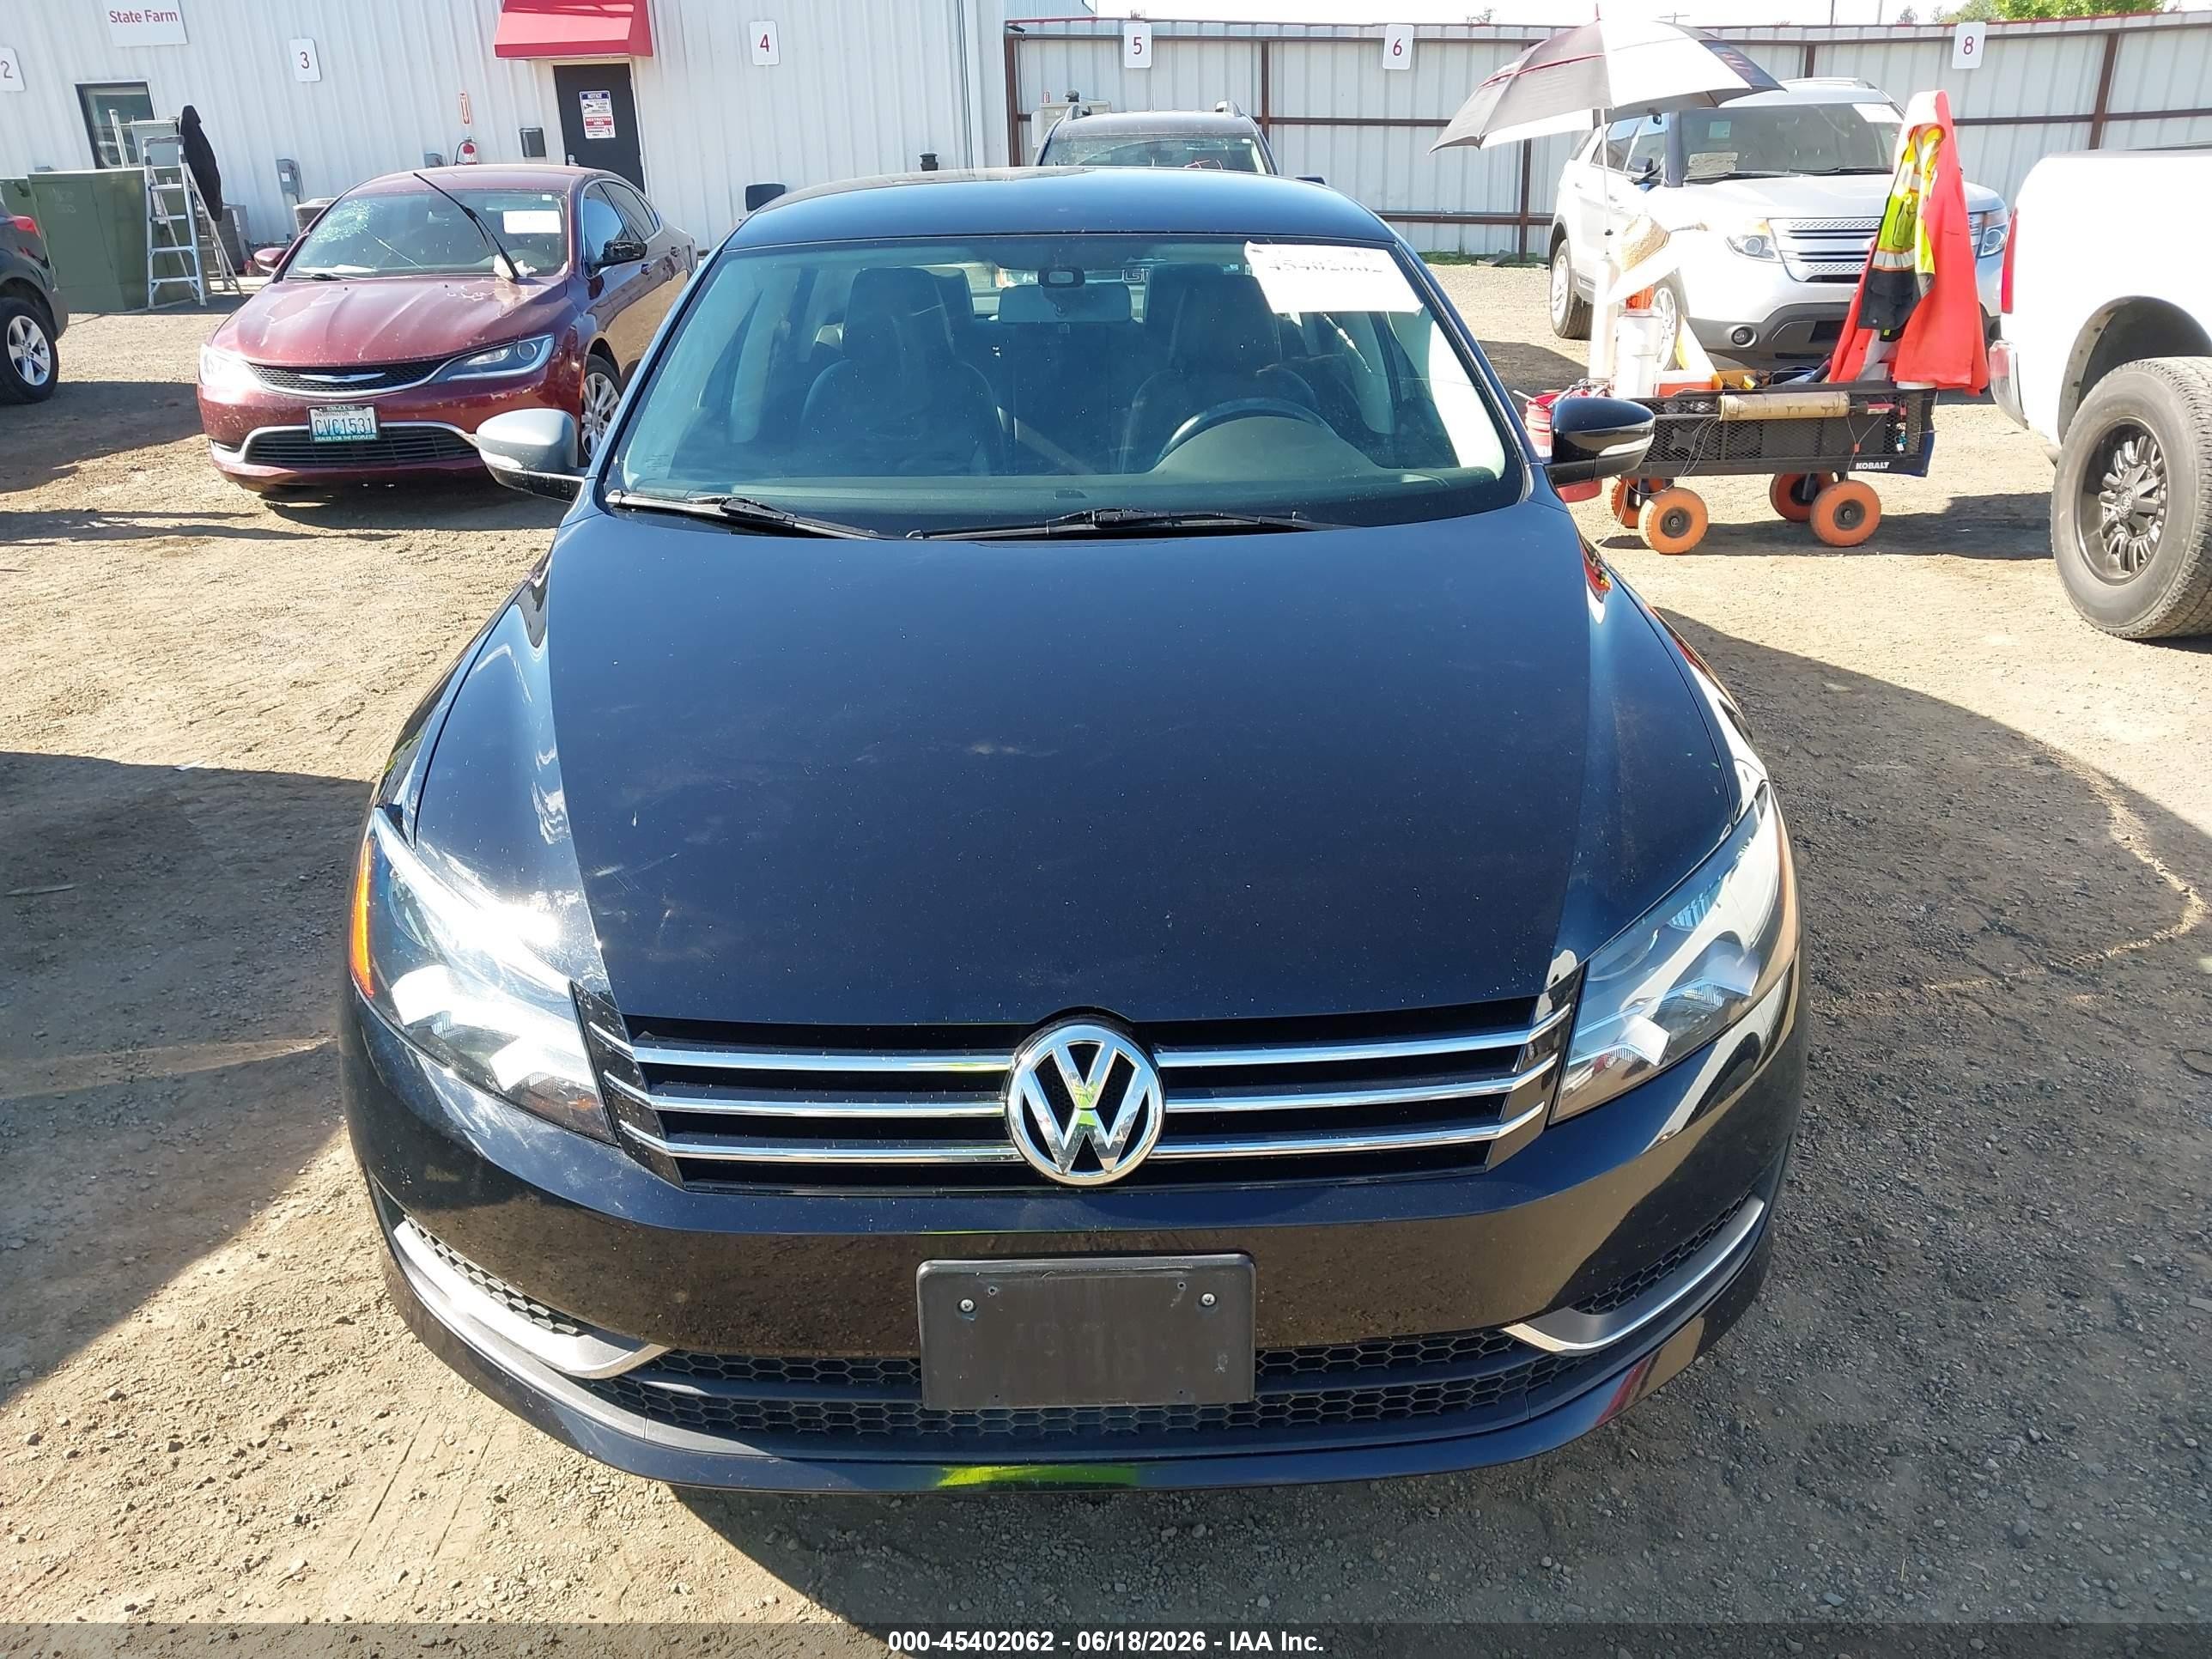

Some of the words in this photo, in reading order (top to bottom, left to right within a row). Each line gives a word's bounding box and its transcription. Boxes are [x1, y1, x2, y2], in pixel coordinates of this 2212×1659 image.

[109, 10, 143, 23] State
[144, 9, 178, 22] Farm
[760, 34, 769, 52] 4
[1133, 37, 1142, 55] 5
[1393, 38, 1402, 56] 6
[1964, 36, 1974, 55] 8
[0, 60, 13, 78] 2
[300, 52, 309, 69] 3
[315, 417, 373, 436] CVC1531
[1856, 461, 1890, 470] KOBALT
